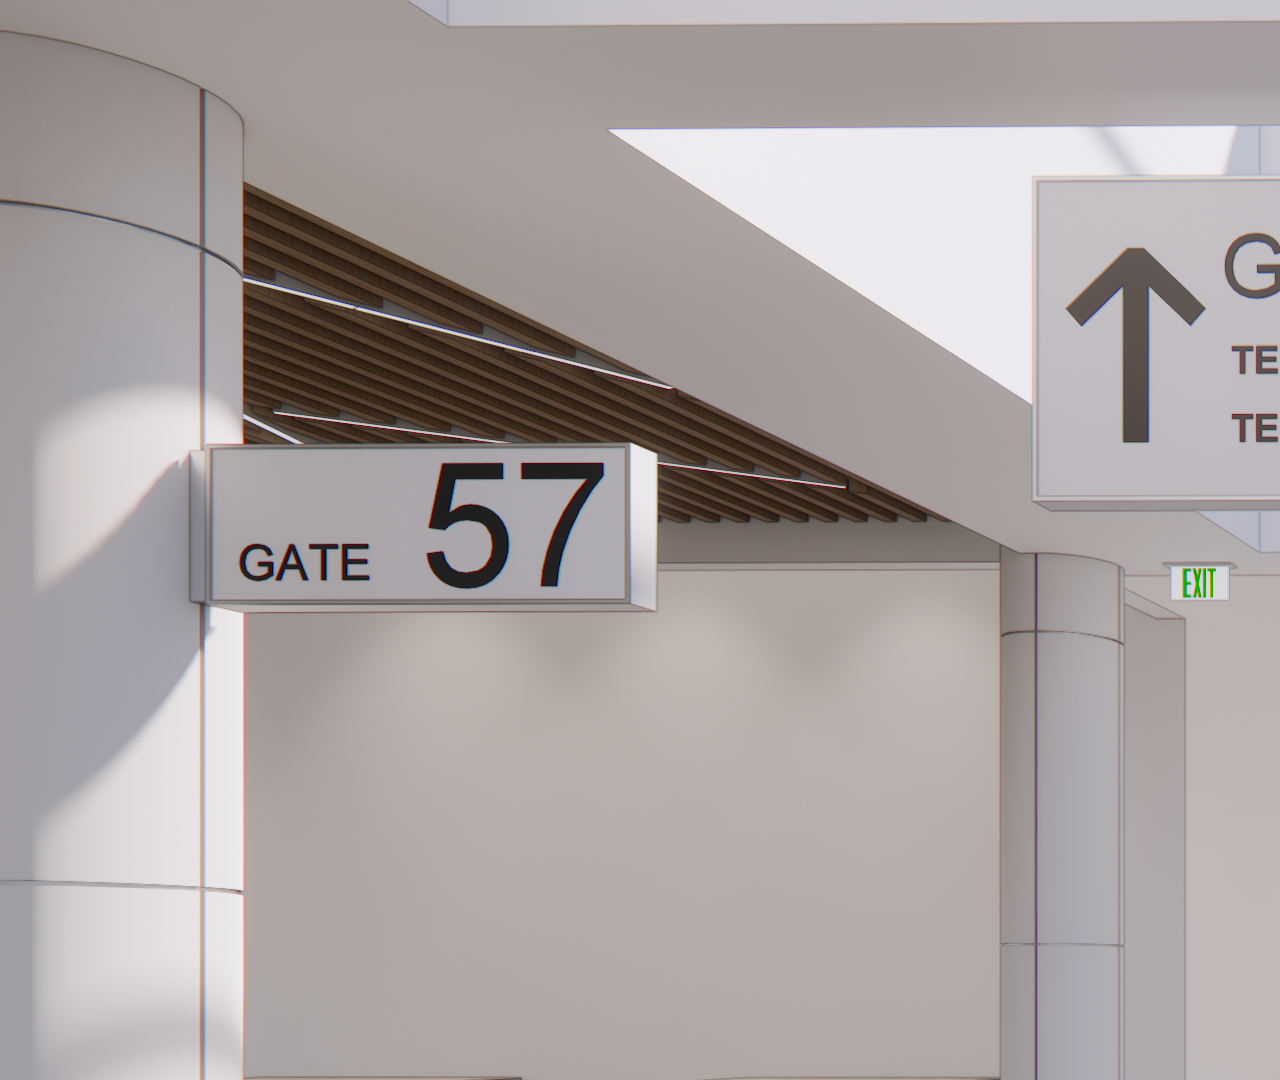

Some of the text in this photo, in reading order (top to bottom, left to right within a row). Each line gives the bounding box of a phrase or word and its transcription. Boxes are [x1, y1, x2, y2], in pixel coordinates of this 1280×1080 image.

[239, 462, 605, 589] GATE 57
[1182, 568, 1216, 598] EXIT
